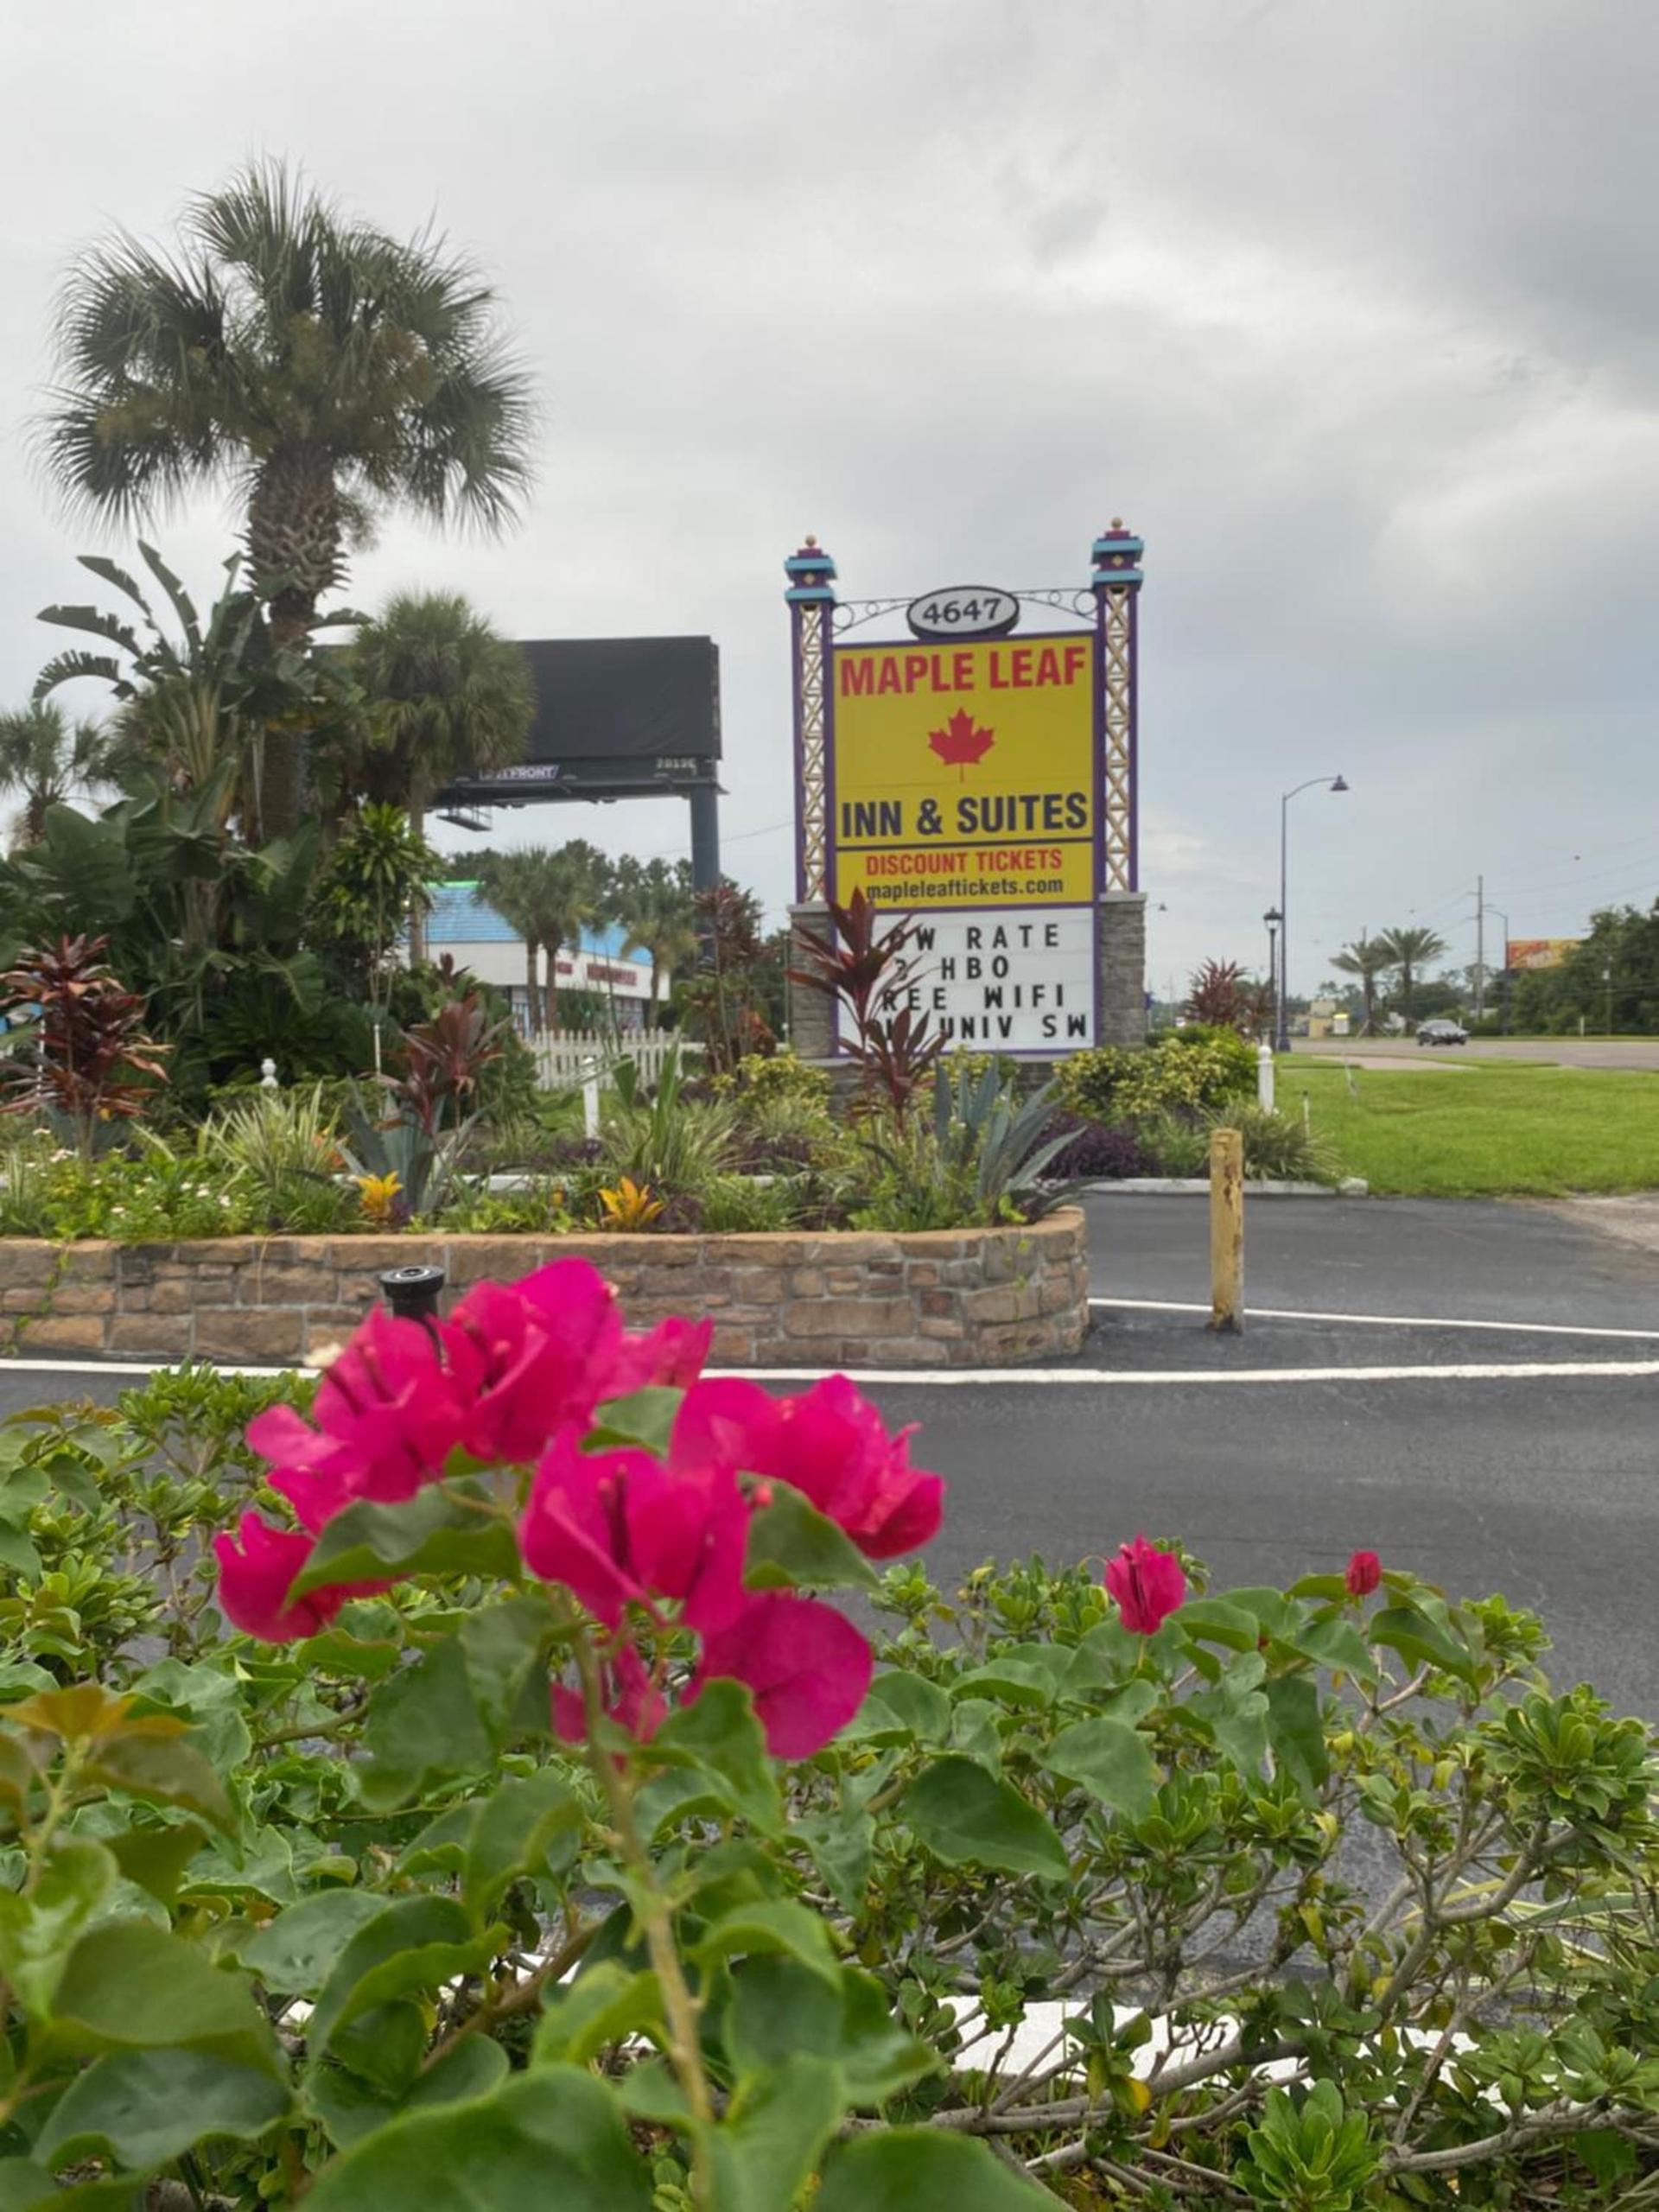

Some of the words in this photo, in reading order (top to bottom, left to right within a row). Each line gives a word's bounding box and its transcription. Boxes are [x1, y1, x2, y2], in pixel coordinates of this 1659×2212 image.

[922, 597, 1001, 625] 4647
[840, 652, 975, 697] MAPLE
[988, 646, 1086, 689] LEAF
[842, 801, 902, 838] INN
[917, 798, 944, 836] &
[957, 791, 1088, 834] SUITES
[867, 852, 968, 876] DISCOUNT
[976, 849, 1063, 873] TICKETS
[867, 878, 1064, 902] mapleleaftickets.com
[967, 924, 1059, 950] RATE
[942, 955, 1009, 981] HBO
[984, 983, 1064, 1010] WIFI
[1042, 1014, 1087, 1039] SW
